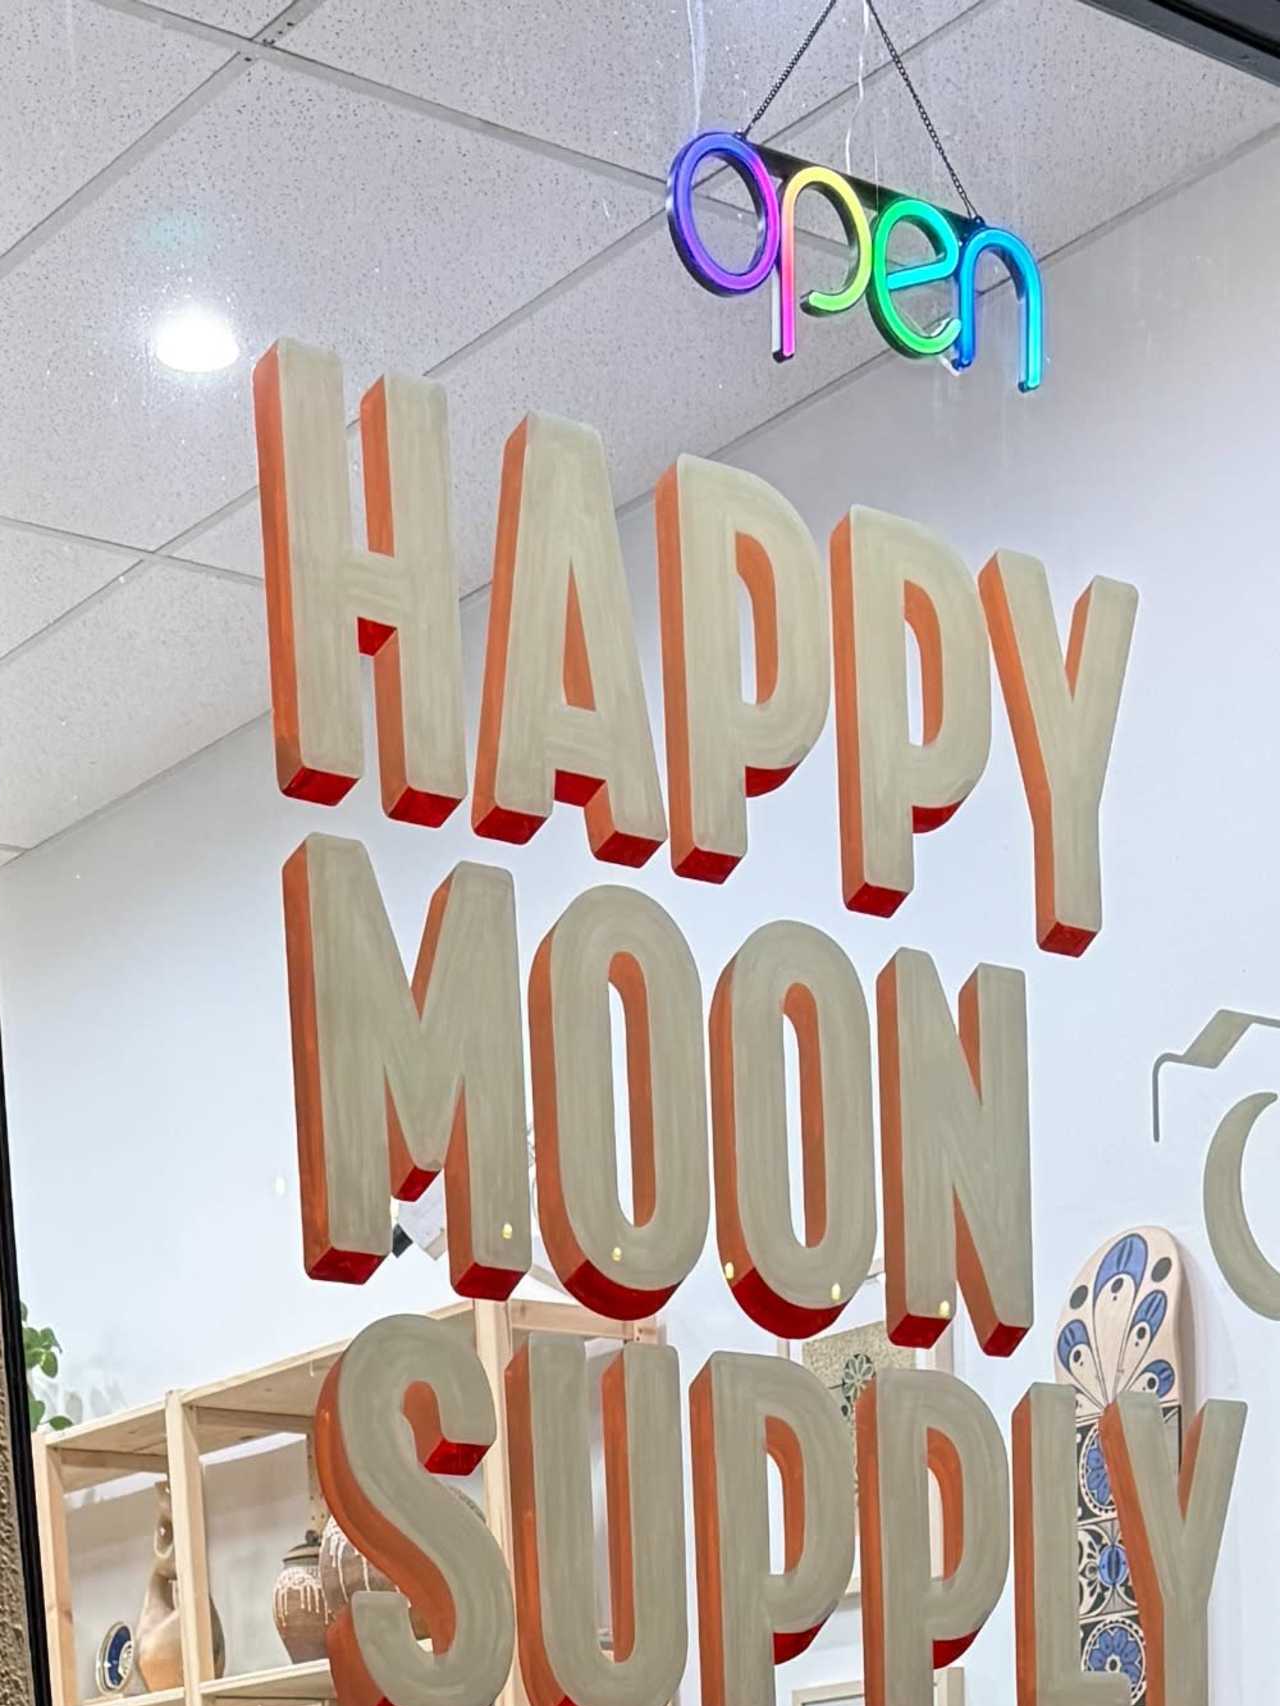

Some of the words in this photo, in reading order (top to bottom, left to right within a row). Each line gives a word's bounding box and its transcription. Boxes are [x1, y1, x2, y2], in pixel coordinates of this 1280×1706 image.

[667, 131, 1045, 393] open
[253, 338, 1139, 956] HAPPY
[283, 833, 1034, 1357] MOON
